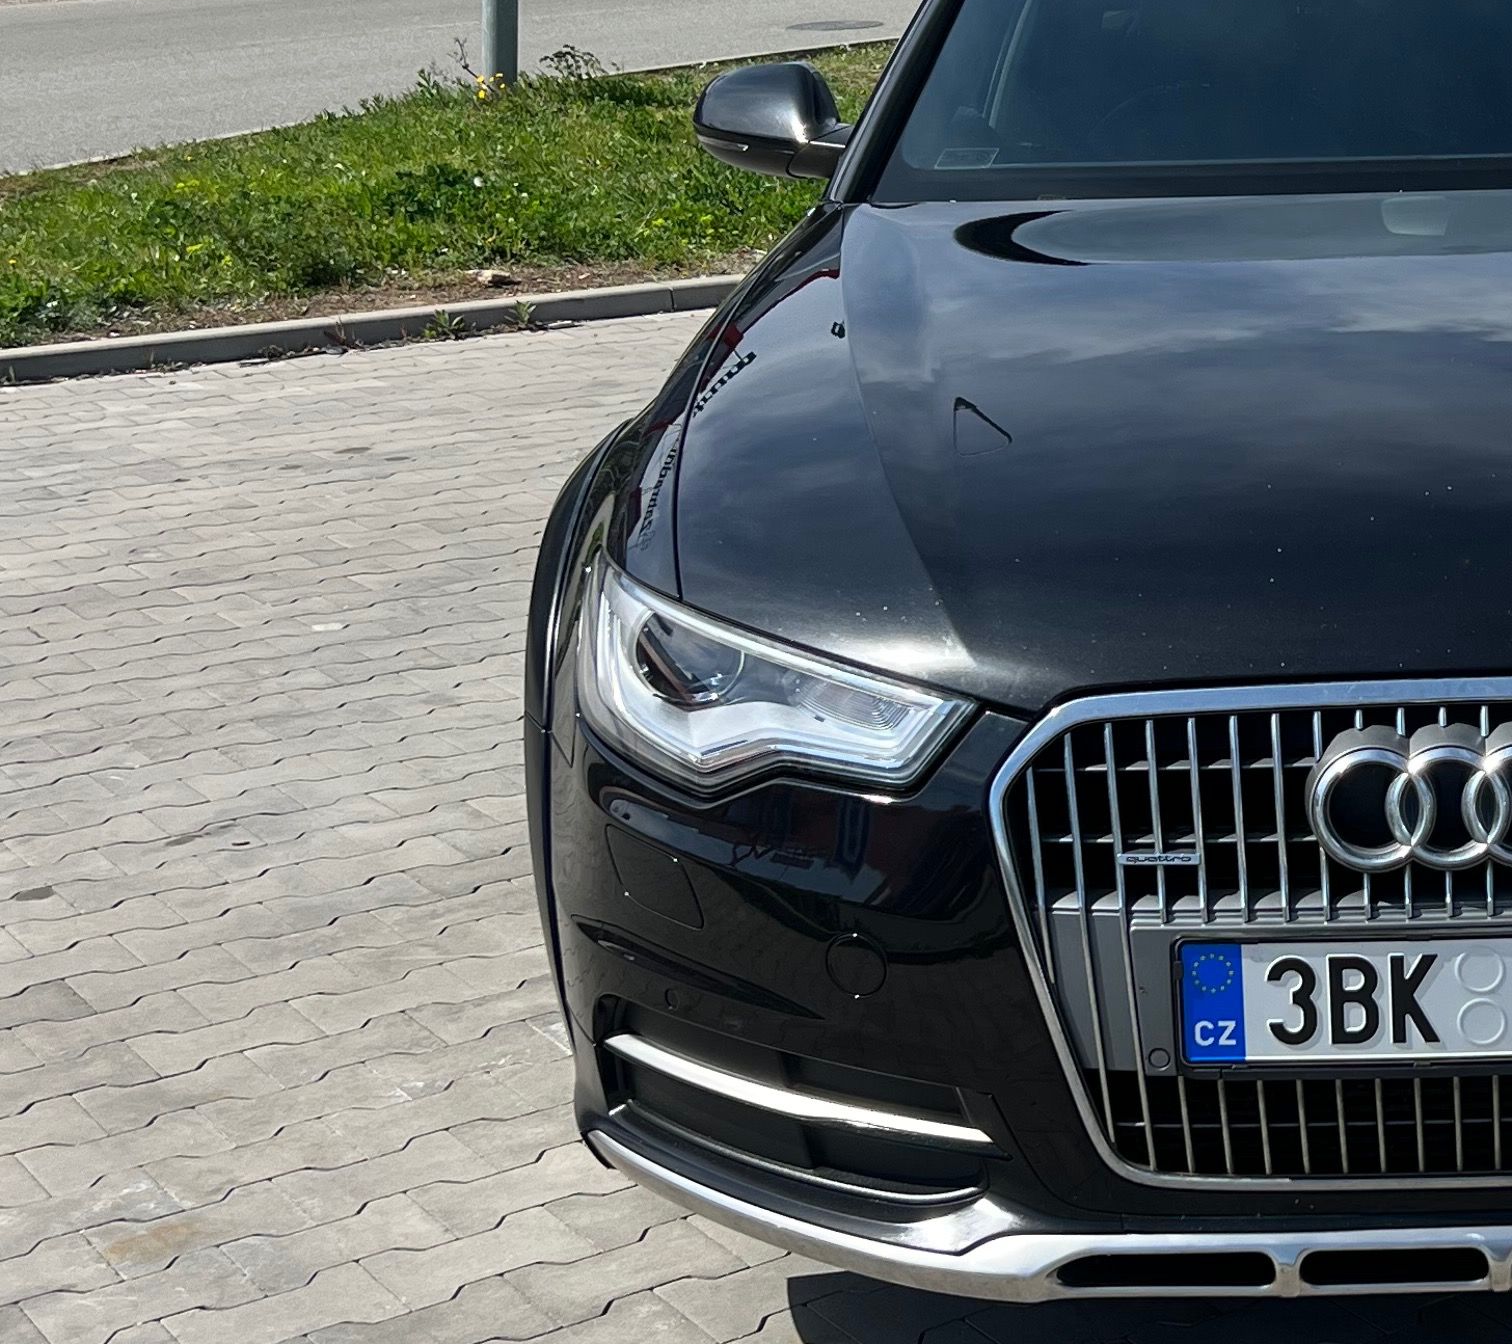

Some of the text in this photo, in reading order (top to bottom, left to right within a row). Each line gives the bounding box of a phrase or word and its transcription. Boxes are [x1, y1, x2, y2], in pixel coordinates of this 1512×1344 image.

[1126, 855, 1192, 864] quattro
[1264, 953, 1441, 1046] 3BK
[1193, 1020, 1238, 1047] CZ
